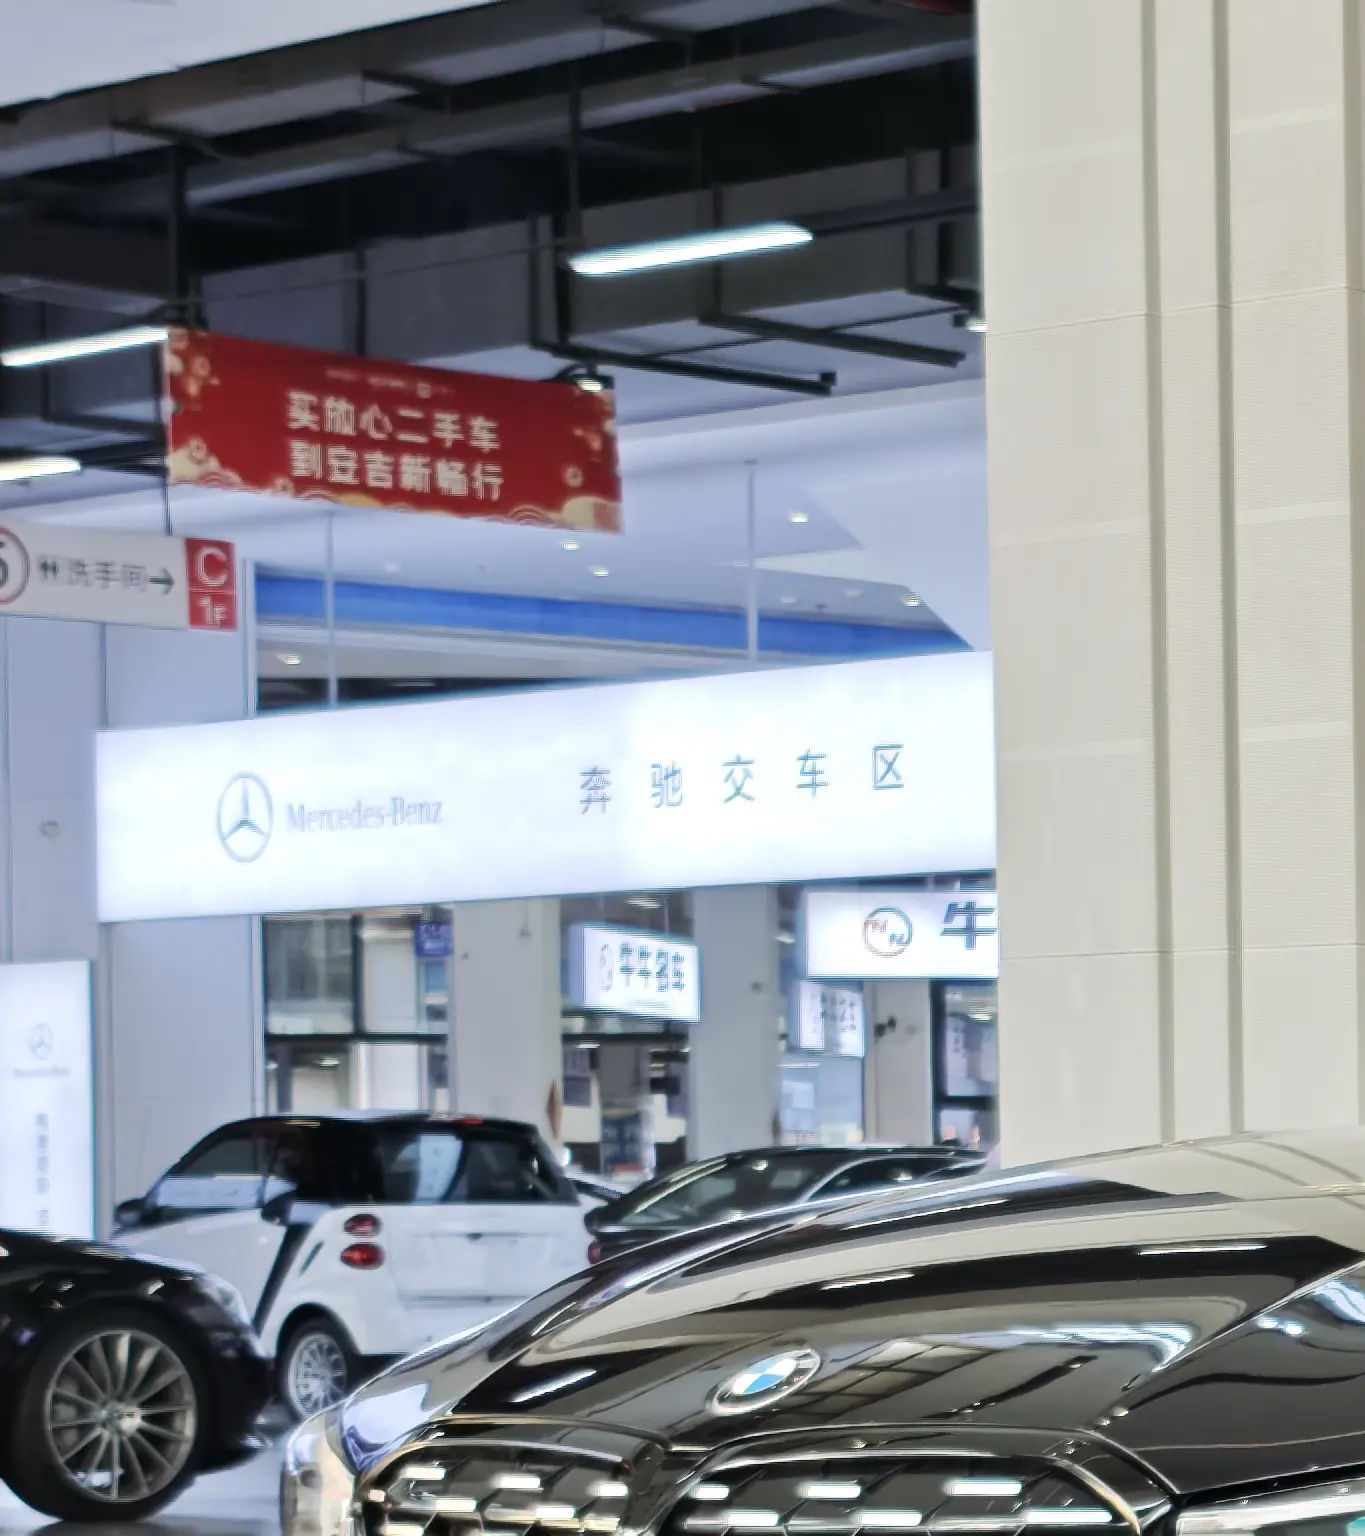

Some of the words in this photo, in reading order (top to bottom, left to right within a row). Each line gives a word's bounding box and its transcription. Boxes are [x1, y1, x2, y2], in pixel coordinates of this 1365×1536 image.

[288, 390, 500, 453] 买放心二手车
[67, 557, 147, 593] 洗手间
[196, 546, 228, 587] C
[579, 743, 905, 815] 奔驰交车区
[286, 796, 443, 833] Mercedes-Benz
[940, 901, 998, 950] 牛
